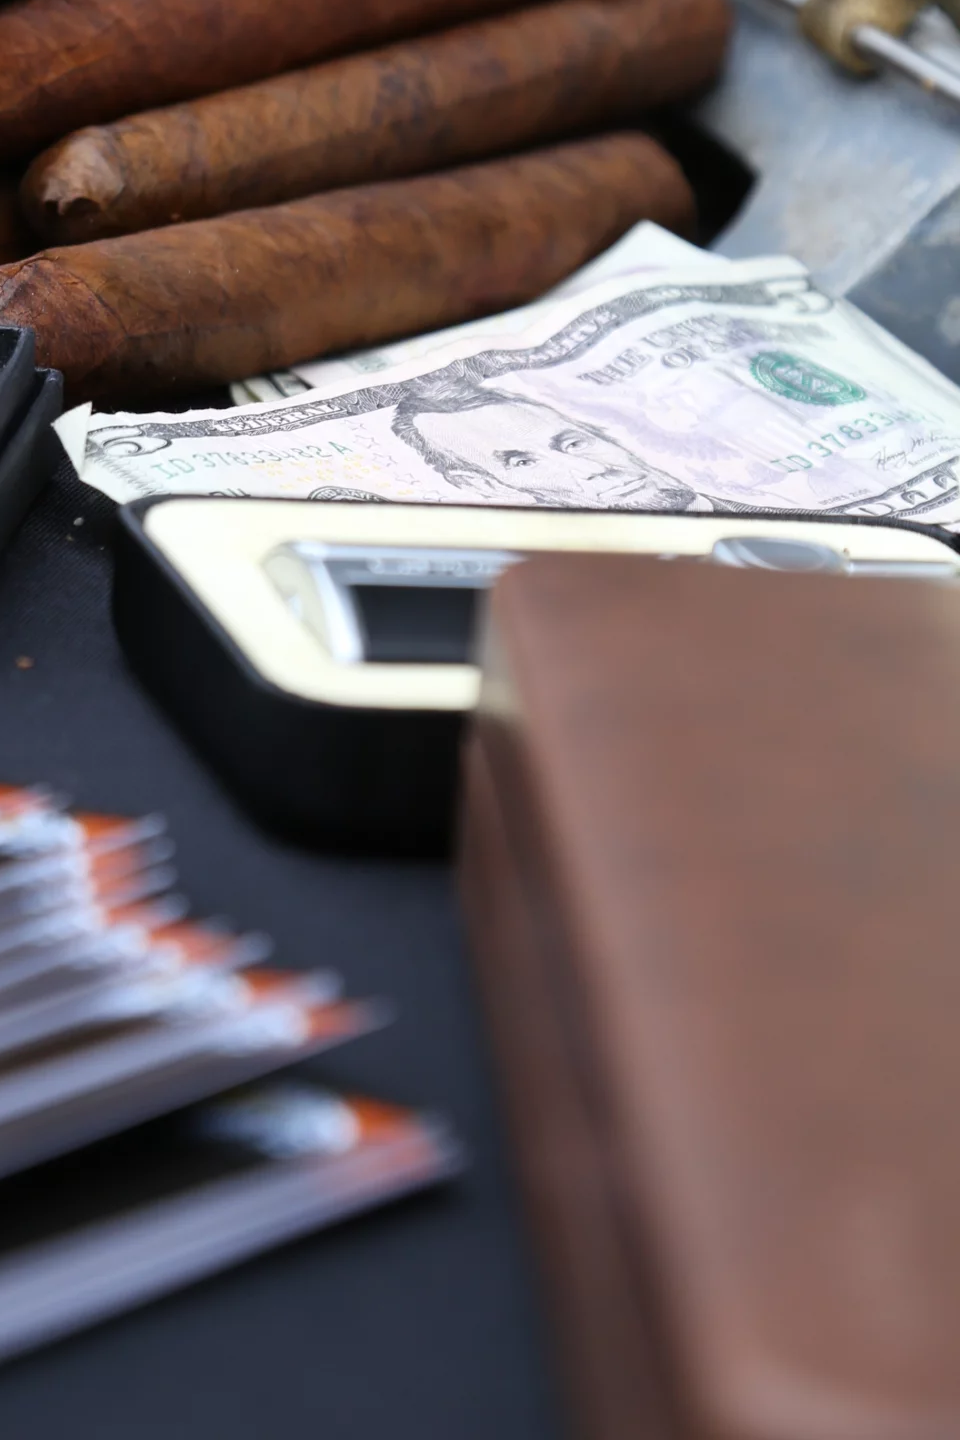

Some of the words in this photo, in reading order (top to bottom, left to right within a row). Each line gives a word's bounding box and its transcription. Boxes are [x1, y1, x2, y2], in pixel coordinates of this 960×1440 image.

[577, 347, 654, 385] THE
[213, 402, 341, 433] FEDERAL
[327, 441, 354, 456] A
